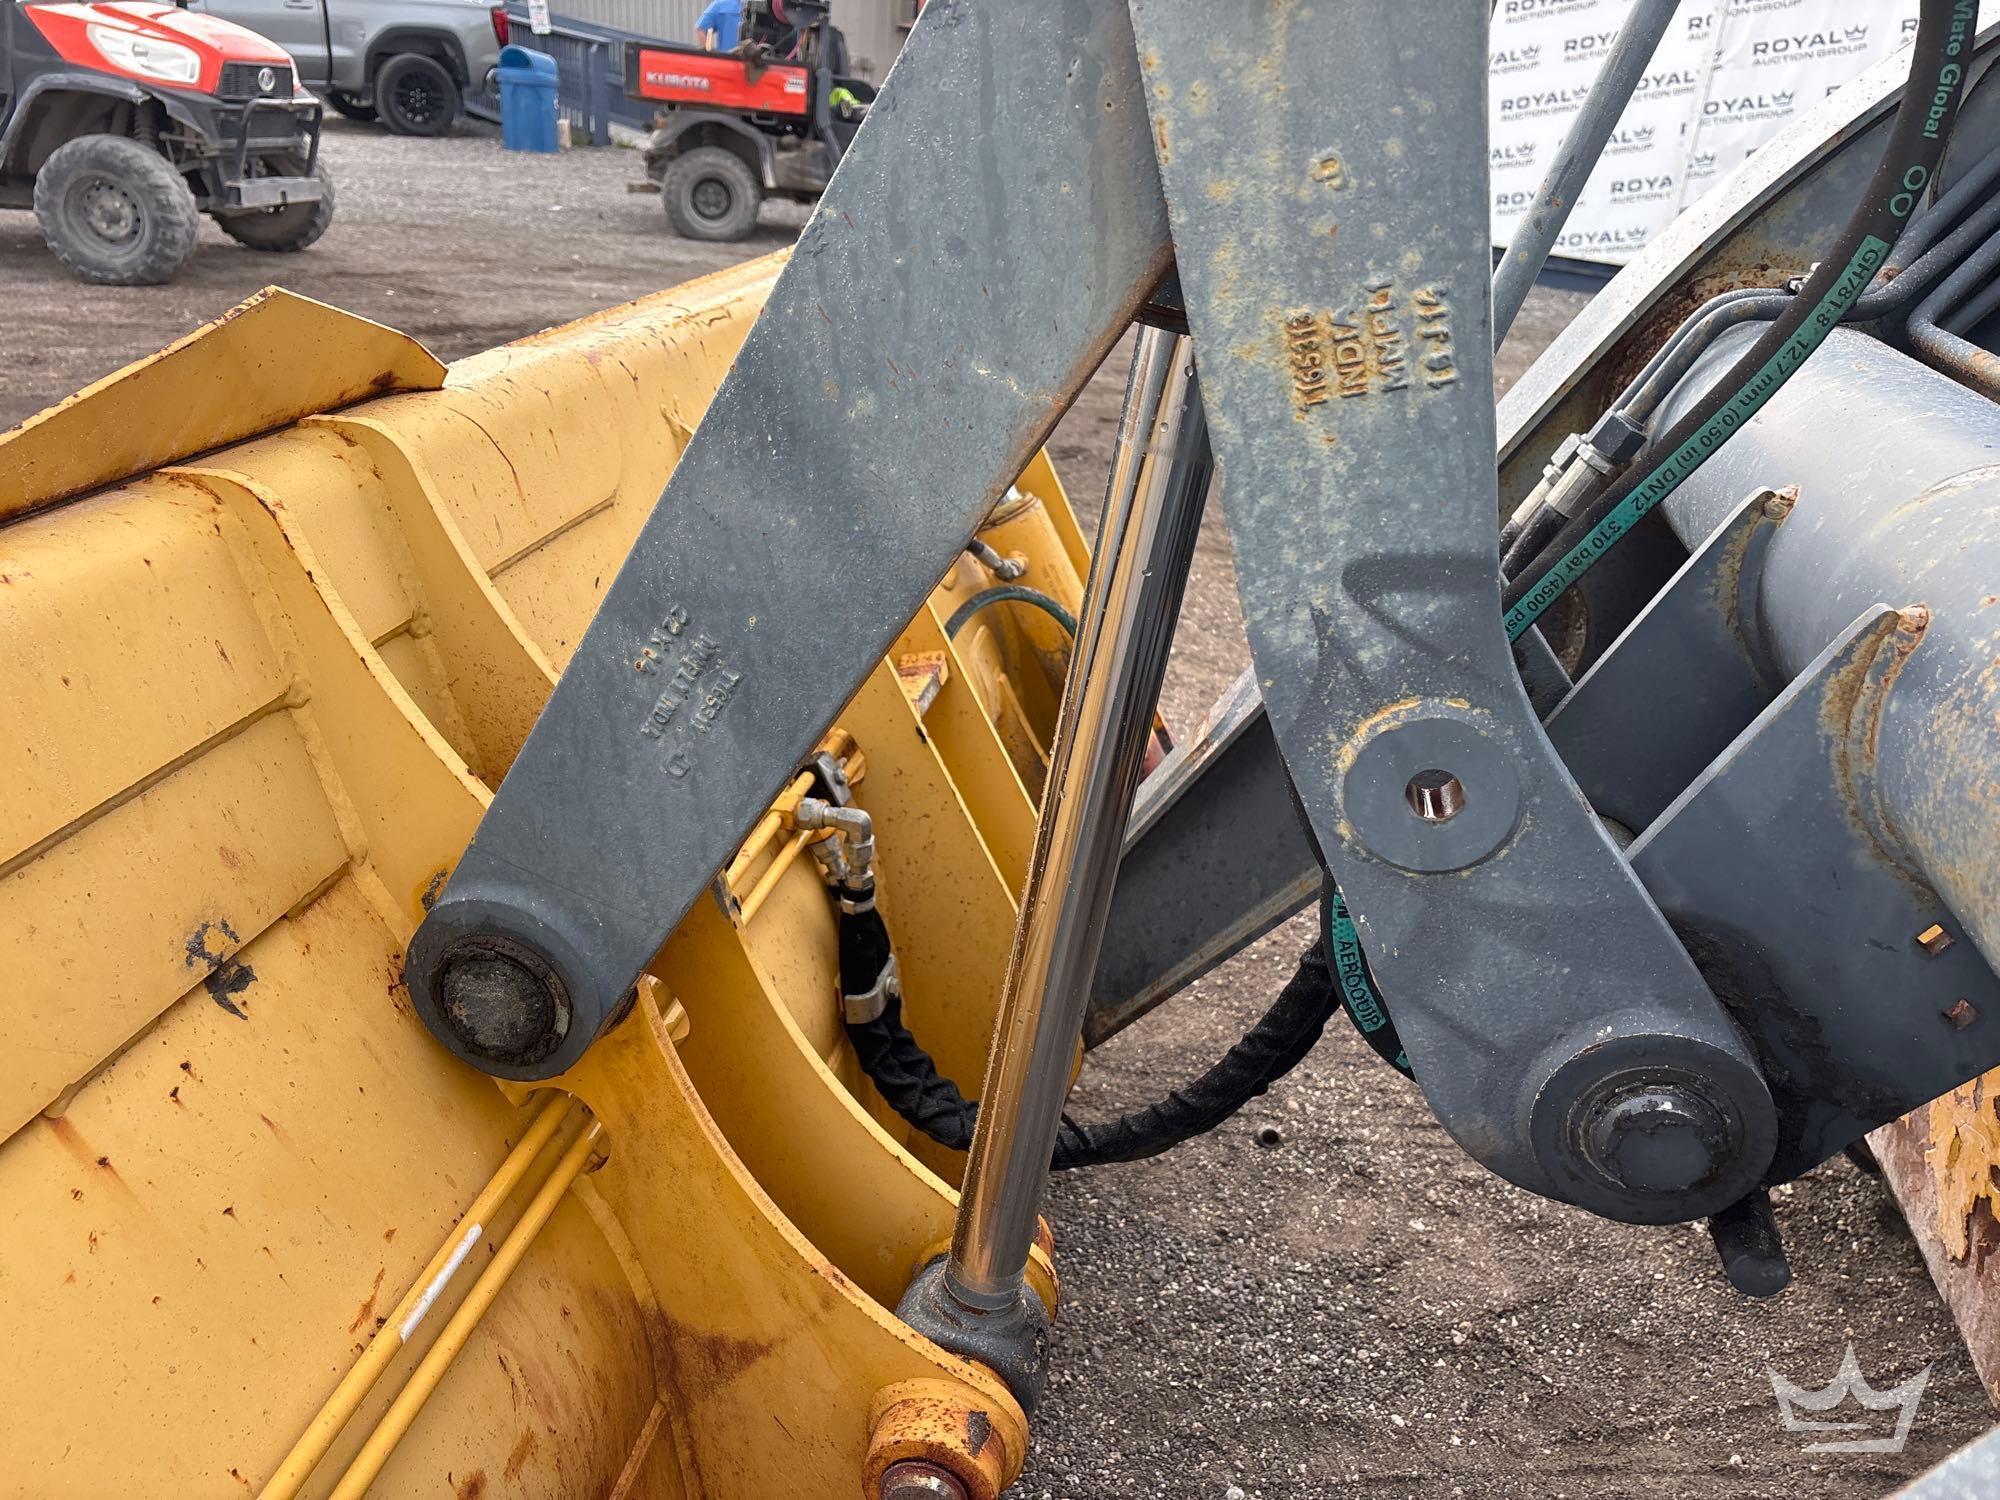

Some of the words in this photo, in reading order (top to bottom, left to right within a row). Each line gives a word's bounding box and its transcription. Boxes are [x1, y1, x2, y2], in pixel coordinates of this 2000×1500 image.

[1752, 51, 1814, 66] AUCTION
[1816, 43, 1867, 57] GROUP
[1753, 31, 1843, 55] ROYAL
[646, 71, 711, 90] KUBOTA
[1501, 89, 1571, 111] ROYAL
[1703, 94, 1769, 116] OYAL
[1922, 63, 1961, 139] Global
[1611, 174, 1672, 194] ROYA
[1816, 249, 1880, 328] GH781-8
[1776, 337, 1809, 377] 12.7
[1740, 374, 1774, 408] mm
[1700, 407, 1740, 448] (0.50
[1675, 446, 1702, 469] in)
[1630, 467, 1678, 512] DN12
[1592, 520, 1622, 550] 310
[1565, 547, 1594, 574] bar
[1526, 572, 1567, 613] (4500
[1504, 609, 1526, 639] psi
[1337, 939, 1381, 1029] AEROQUIP
